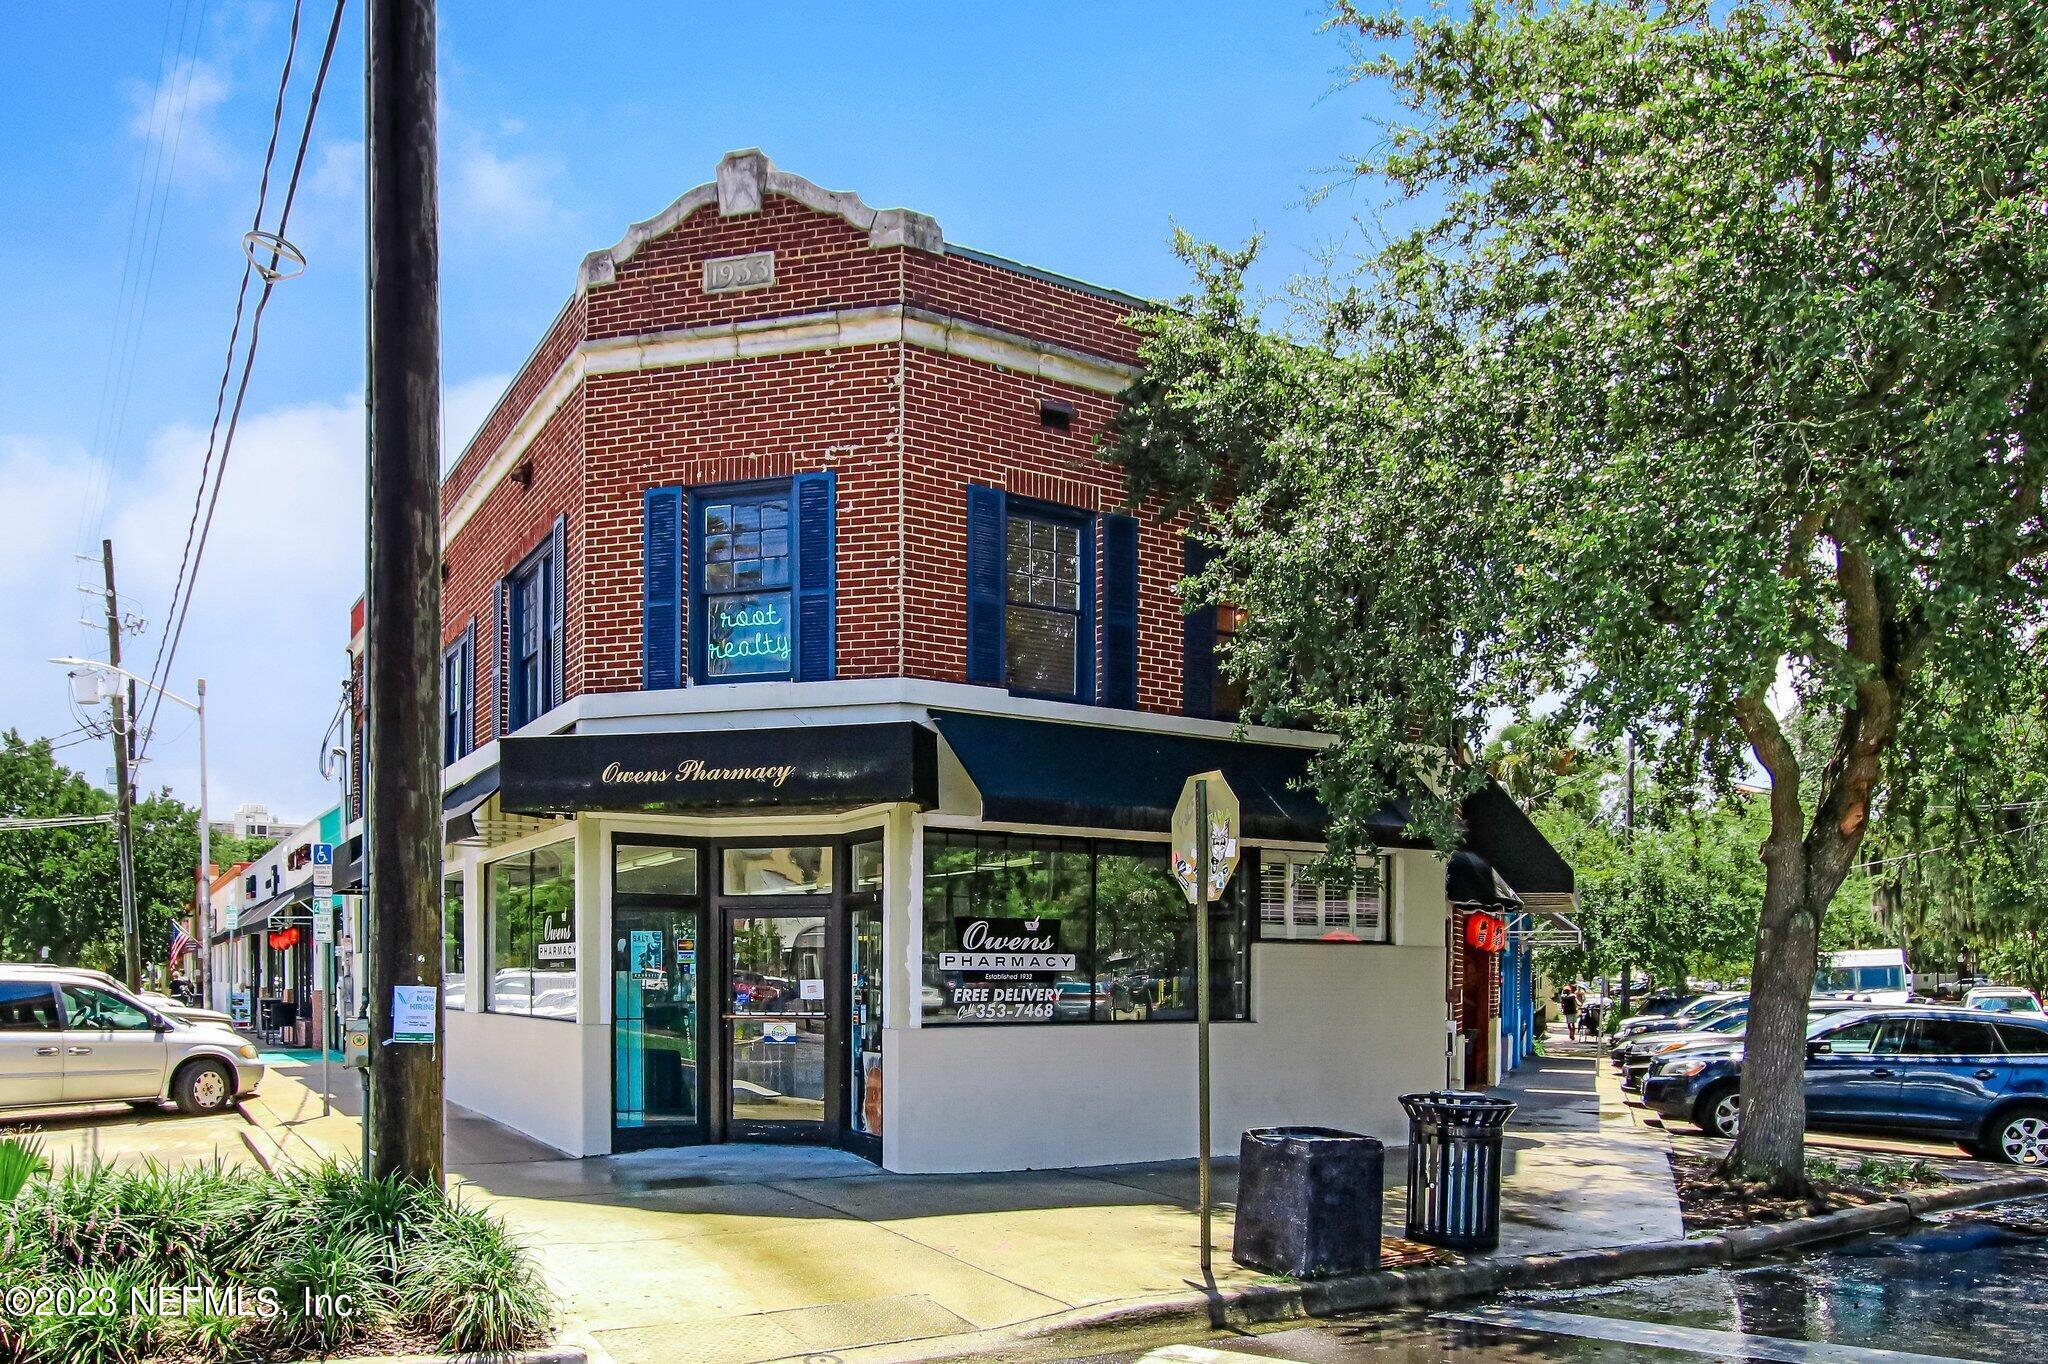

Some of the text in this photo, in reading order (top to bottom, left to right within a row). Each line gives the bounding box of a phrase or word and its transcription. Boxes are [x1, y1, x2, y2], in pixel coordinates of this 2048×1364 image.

[712, 259, 769, 287] 1933
[720, 603, 782, 628] root
[708, 632, 791, 659] realty
[601, 759, 796, 787] Owens Pharmacy
[962, 920, 1055, 951] Owens
[944, 955, 1071, 967] PHARMACY
[953, 988, 1063, 1003] FREE DELIVERY
[975, 1003, 1054, 1018] 353-7468
